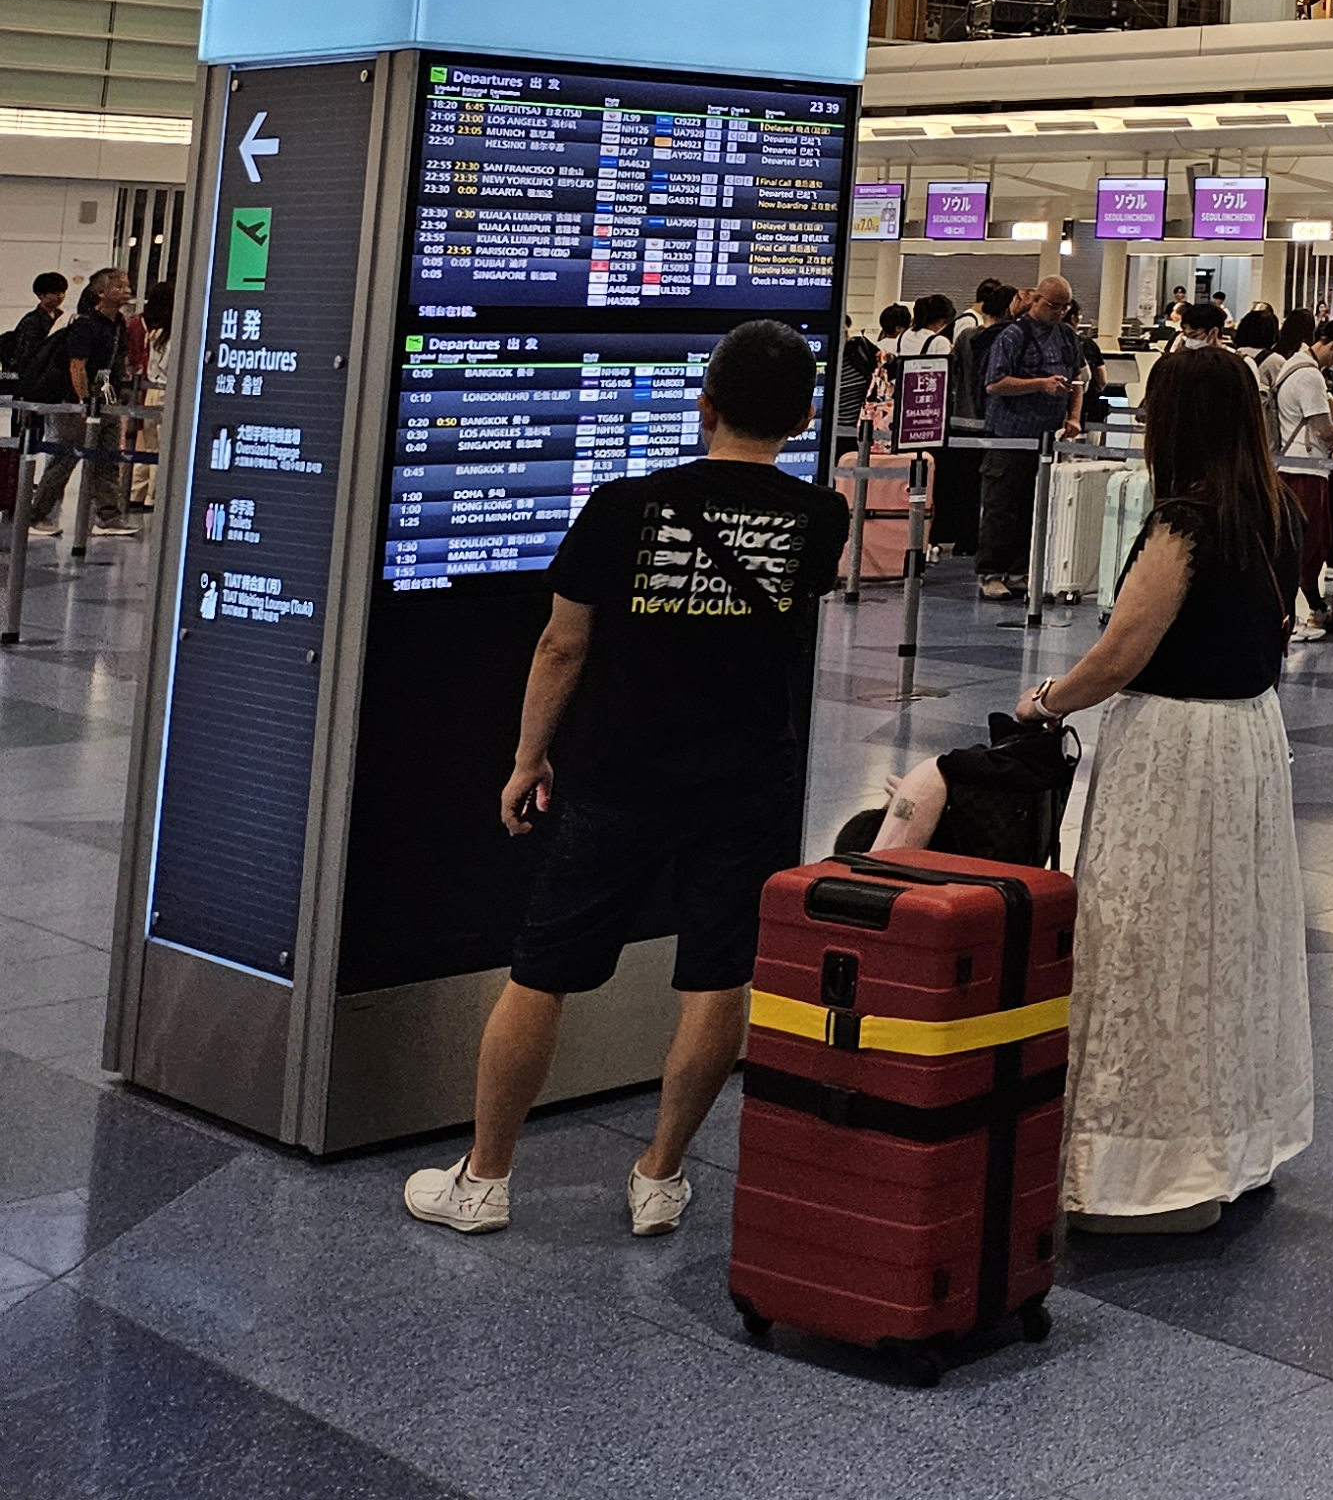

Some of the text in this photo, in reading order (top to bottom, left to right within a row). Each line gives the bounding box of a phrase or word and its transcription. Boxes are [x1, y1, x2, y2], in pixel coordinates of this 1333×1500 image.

[453, 71, 523, 87] Departures
[433, 100, 457, 109] 18:20
[465, 103, 484, 111] 6:45
[810, 102, 839, 114] 23 39
[431, 112, 797, 144] 21:05 23:00 LOS ANGELES Departed
[430, 124, 796, 154] 22:45 23:05 MUNICH Departed
[428, 136, 454, 145] 22:50
[485, 139, 525, 149] HELSINKI
[762, 157, 795, 166] Departed
[426, 160, 452, 169] 22:55
[455, 162, 479, 170] 23:30
[483, 164, 501, 172] SAN
[505, 164, 554, 174] FRANCISCO
[425, 173, 450, 181] 22:55
[453, 174, 478, 182] 23:35
[482, 175, 505, 183] NEW
[759, 189, 793, 198] Departed
[424, 185, 449, 193] 23:30
[457, 186, 477, 194] 0:00
[480, 188, 523, 196] JAKARTA
[777, 202, 808, 210] Boarding
[1115, 193, 1147, 210] ソウル
[1212, 193, 1247, 209] ソウル
[942, 197, 971, 211] ソウル
[422, 209, 448, 217] 23:30
[479, 212, 511, 220] KUALA
[513, 212, 552, 221] LUMPUR
[421, 221, 446, 229] 23:50
[512, 224, 551, 232] LUMPUR
[756, 233, 773, 241] Gate
[420, 233, 445, 242] 23:55
[477, 235, 509, 243] KUALA
[511, 236, 549, 245] LUMPUR
[424, 246, 444, 254] 0:05
[446, 246, 472, 254] 23:55
[423, 258, 505, 268] 0:05 0:05 DUBAI
[421, 270, 526, 280] 0:05 SINGAPORE
[221, 309, 261, 339] 出発
[429, 338, 500, 350] Departures
[218, 343, 297, 374] Departures
[412, 369, 512, 378] 0:05 BANGKOK
[410, 394, 431, 402] 0:10
[408, 418, 429, 427] 0:20
[461, 417, 508, 425] BANGKOK
[407, 428, 521, 439] 0:30 LOS ANGELES
[236, 441, 300, 461] Oversized Baggage
[406, 441, 511, 452] 0:40 SINGAPORE
[403, 465, 504, 476] 0:45 BANGKOK
[402, 490, 483, 501] 1:00 DOHA
[401, 501, 512, 513] 1:00 HONG KONG
[400, 518, 419, 526] 1:25
[451, 515, 467, 524] HO
[398, 542, 417, 551] 1:30
[396, 550, 487, 563] 1:30 MANILA
[395, 562, 486, 576] 1:55 MANILA
[265, 596, 290, 615] Lounge
[631, 592, 792, 615] new balae
